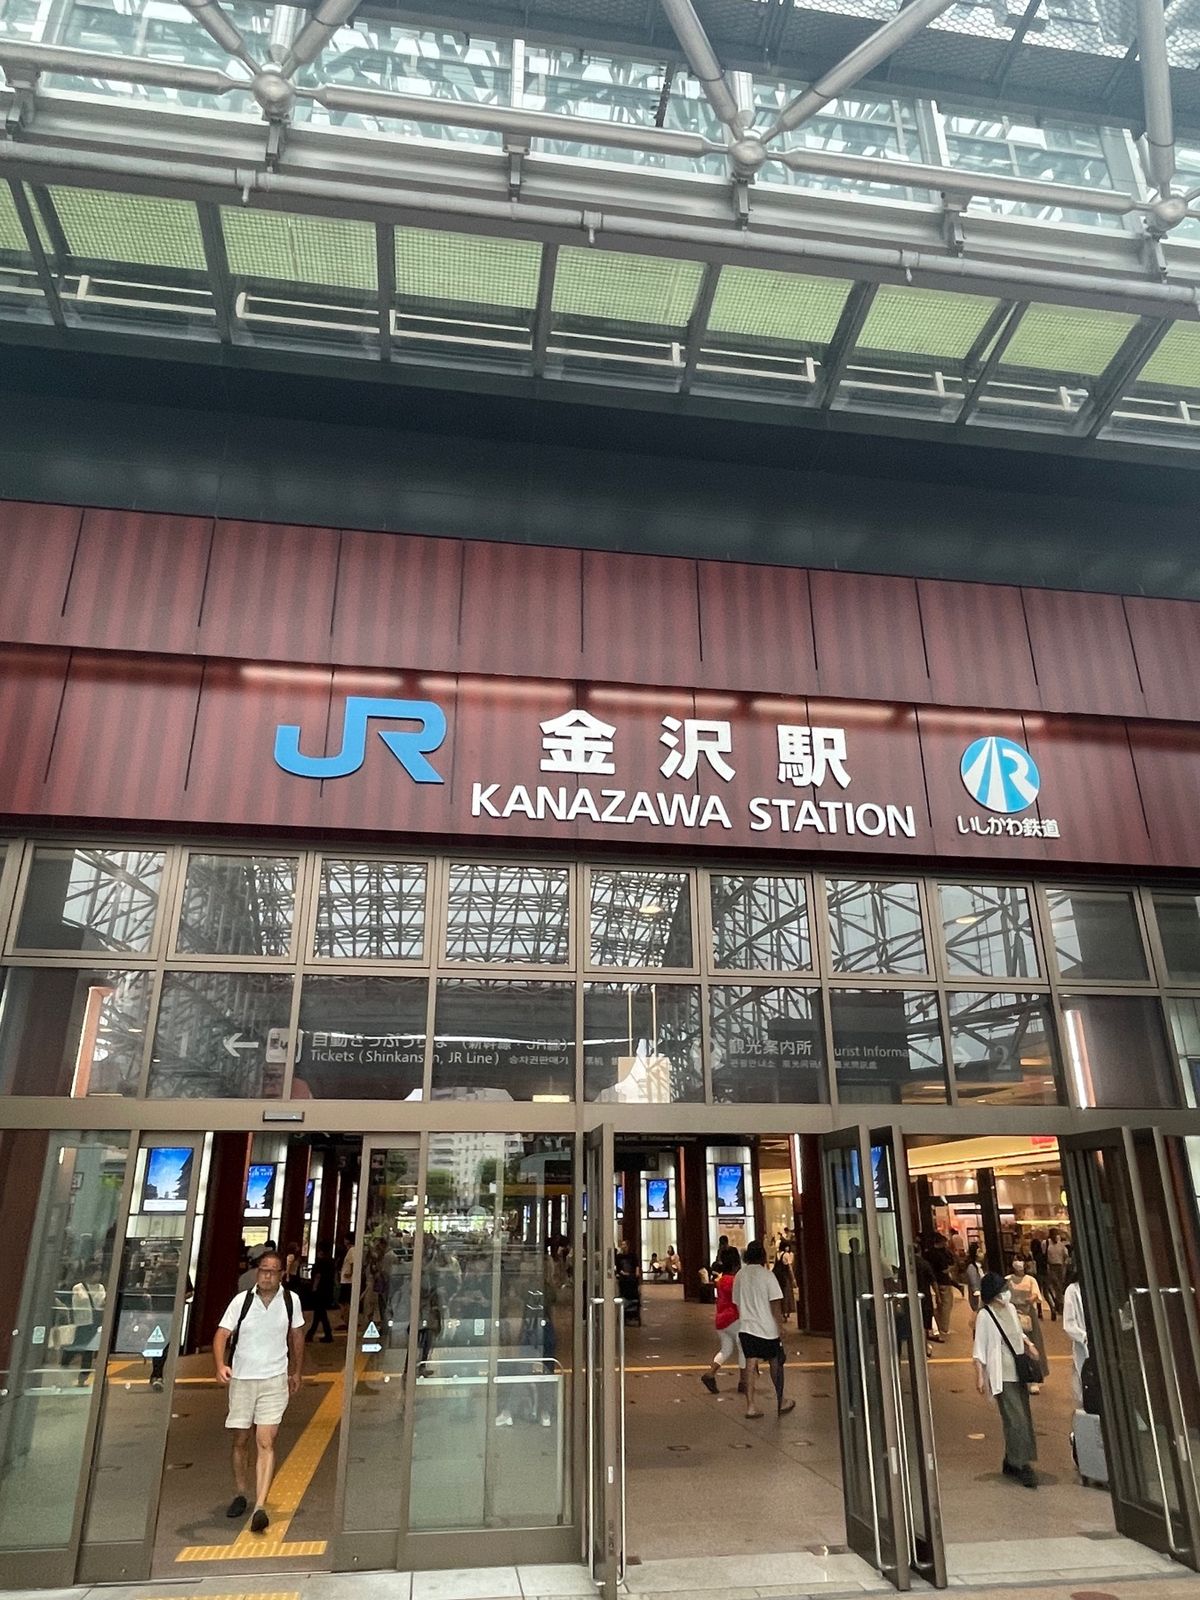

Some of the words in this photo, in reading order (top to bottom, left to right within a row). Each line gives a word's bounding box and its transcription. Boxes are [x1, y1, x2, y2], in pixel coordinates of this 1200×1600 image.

[274, 696, 447, 784] JR
[539, 708, 852, 790] 金沢駅
[471, 782, 732, 829] KANAZAWA
[748, 796, 917, 838] STATION
[957, 815, 1061, 838] いしかわ鉄道
[311, 1049, 354, 1061] Tickets
[359, 1050, 443, 1065] (Shinkansn,
[448, 1052, 462, 1063] JR
[466, 1051, 499, 1065] Line)
[729, 1038, 813, 1056] 観光案内所
[834, 1044, 860, 1057] urist
[994, 1045, 1012, 1071] 2
